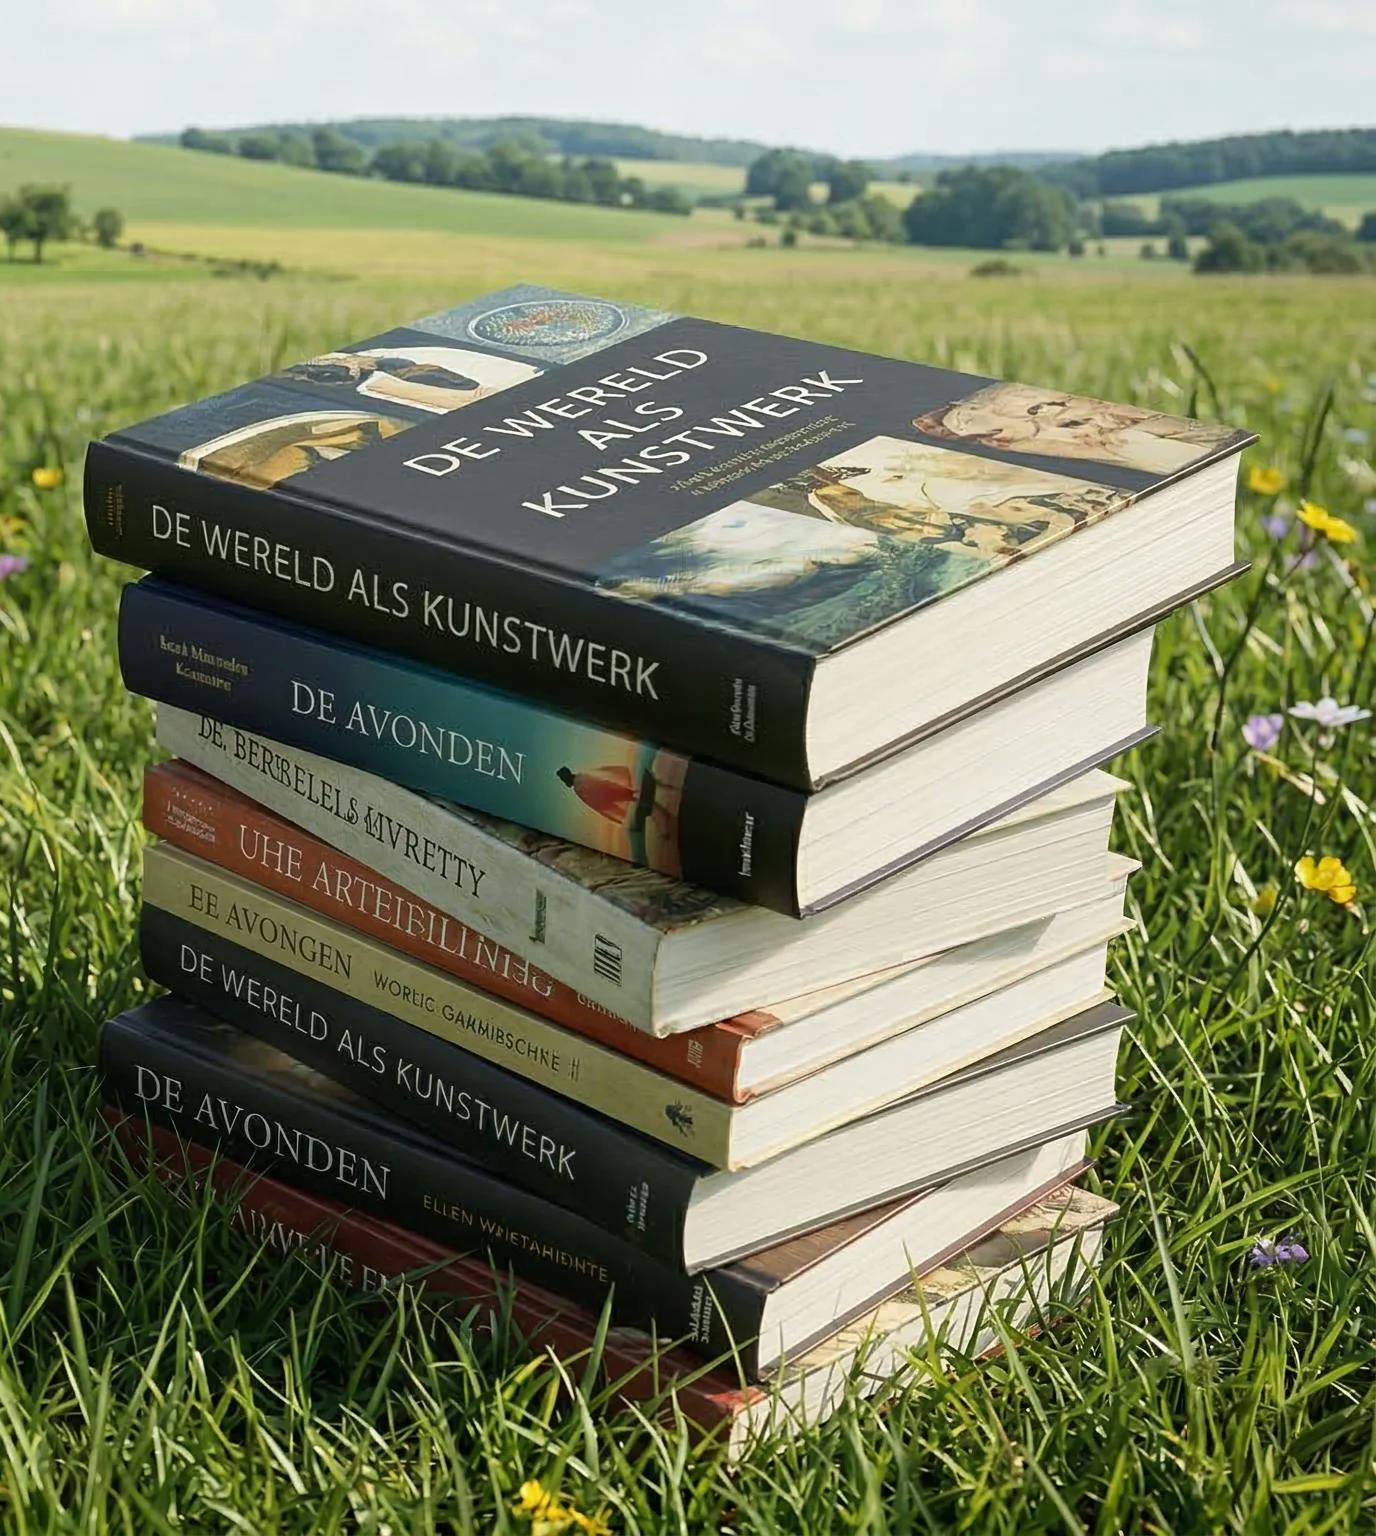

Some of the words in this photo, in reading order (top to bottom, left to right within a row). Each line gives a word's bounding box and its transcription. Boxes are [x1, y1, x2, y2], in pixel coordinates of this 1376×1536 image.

[403, 438, 501, 478] DE
[483, 347, 708, 438] WERELD
[522, 370, 864, 519] KUNSTWERK
[576, 402, 685, 452] ALS
[152, 505, 191, 549] DE
[201, 519, 335, 593] WERELD
[348, 568, 409, 618] ALS
[422, 593, 661, 702] KUNSTWERK
[290, 680, 338, 724] DE
[344, 700, 527, 785] AVONDEN
[240, 824, 303, 882] UHE
[226, 902, 353, 980] AVONGEN
[181, 946, 214, 979] DE
[221, 962, 329, 1042] WERELD
[338, 1028, 387, 1075] ALS
[395, 1061, 577, 1182] KUNSTWERK
[134, 1065, 183, 1115] DE
[194, 1095, 391, 1201] AVONDEN
[423, 1194, 474, 1227] ELLEN
